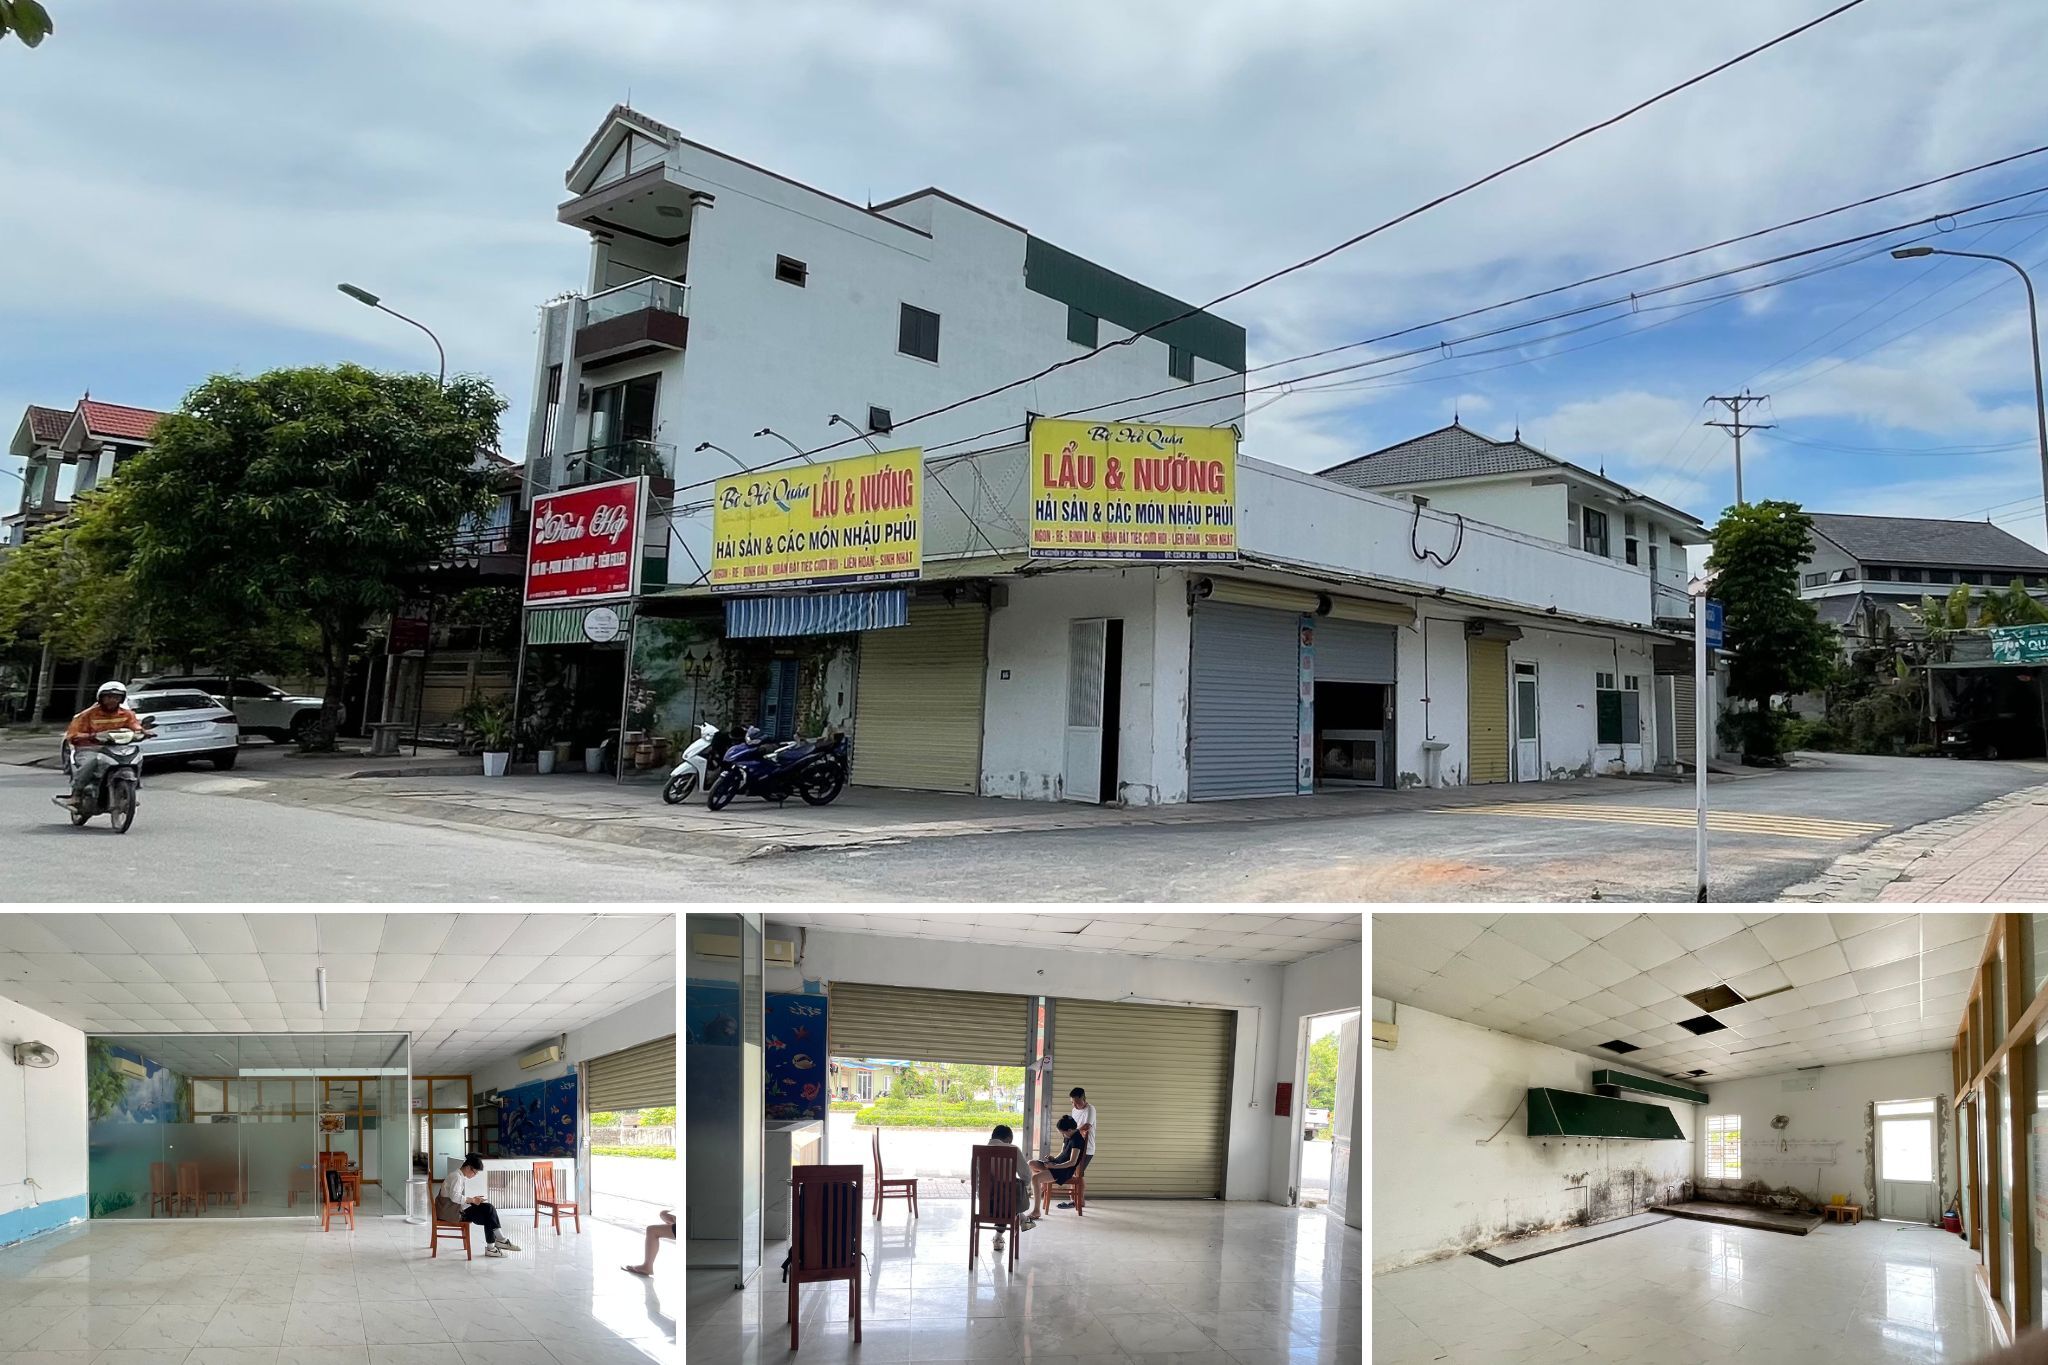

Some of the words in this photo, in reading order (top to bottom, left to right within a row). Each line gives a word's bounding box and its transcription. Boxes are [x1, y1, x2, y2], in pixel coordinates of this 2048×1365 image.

[812, 466, 840, 519] LẨU
[844, 478, 855, 515] &
[860, 464, 913, 514] NƯỚNG
[1043, 440, 1096, 490] LẨU
[1104, 456, 1126, 491] &
[1133, 452, 1226, 494] NƯỚNG
[1036, 493, 1058, 522] HẢI
[1062, 494, 1088, 522] SẢN
[1092, 502, 1102, 523] &
[1106, 498, 1132, 524] CÁC
[1136, 497, 1165, 525] MÓN
[1168, 501, 1202, 529] NHẬU
[1205, 499, 1233, 526] PHỦI
[716, 534, 736, 559] HẢI
[739, 533, 762, 558] SẢN
[765, 536, 773, 555] &
[777, 525, 805, 553] CÁC
[809, 525, 838, 550] MÓN
[843, 520, 880, 551] NHẬU
[885, 514, 917, 543] PHỦI
